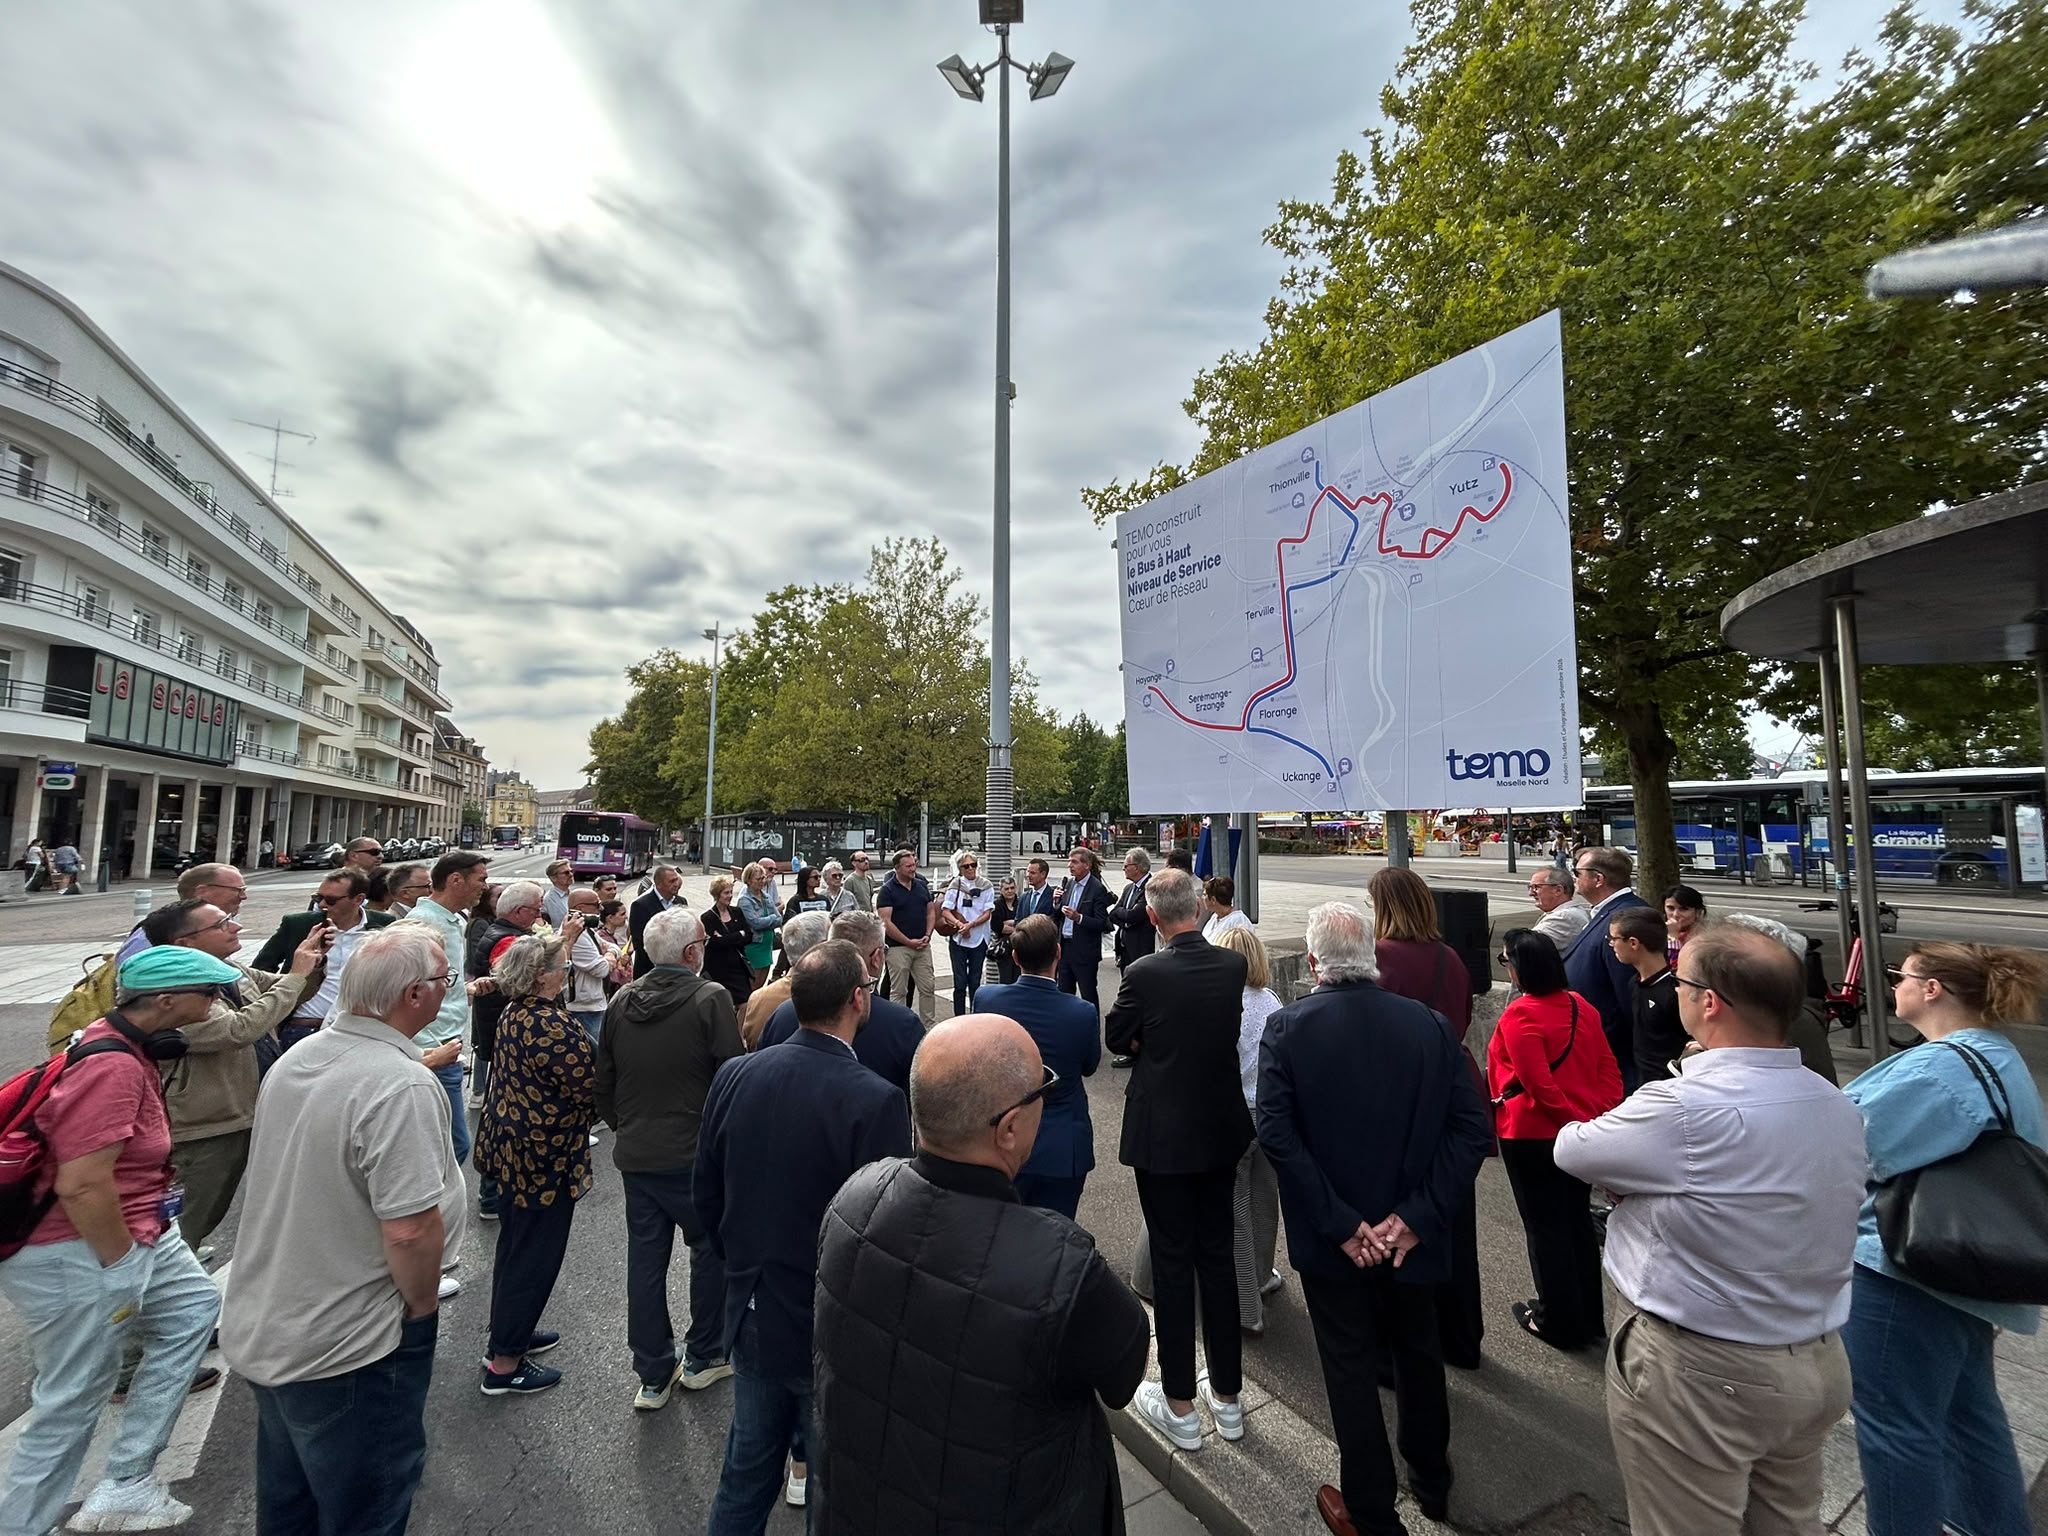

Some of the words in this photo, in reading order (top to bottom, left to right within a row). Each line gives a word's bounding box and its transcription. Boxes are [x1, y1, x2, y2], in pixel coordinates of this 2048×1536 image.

[1269, 470, 1311, 494] Thionville
[1449, 477, 1479, 495] Yutz
[1126, 523, 1154, 547] TEMO
[1156, 504, 1202, 536] construit
[1126, 542, 1148, 564] pour
[1149, 534, 1172, 552] vous
[1127, 564, 1136, 580] le
[1137, 557, 1156, 576] Bus
[1157, 553, 1164, 569] à
[1165, 543, 1192, 565] Haut
[1128, 574, 1162, 597] Niveau
[1163, 566, 1177, 585] de
[1178, 552, 1222, 580] Service
[1128, 595, 1155, 614] Cœur
[1156, 588, 1169, 605] de
[1171, 577, 1209, 600] Réseau
[1245, 605, 1275, 622] Terville
[1135, 673, 1163, 685] Hayange
[1196, 701, 1225, 712] Erzange
[1259, 706, 1298, 719] Florange
[1446, 748, 1550, 780] temo
[1282, 772, 1321, 784] Uckange
[1496, 779, 1527, 787] Moselle
[1528, 778, 1549, 786] Nord
[1873, 834, 1933, 847] Grand
[1899, 828, 1927, 837] Région
